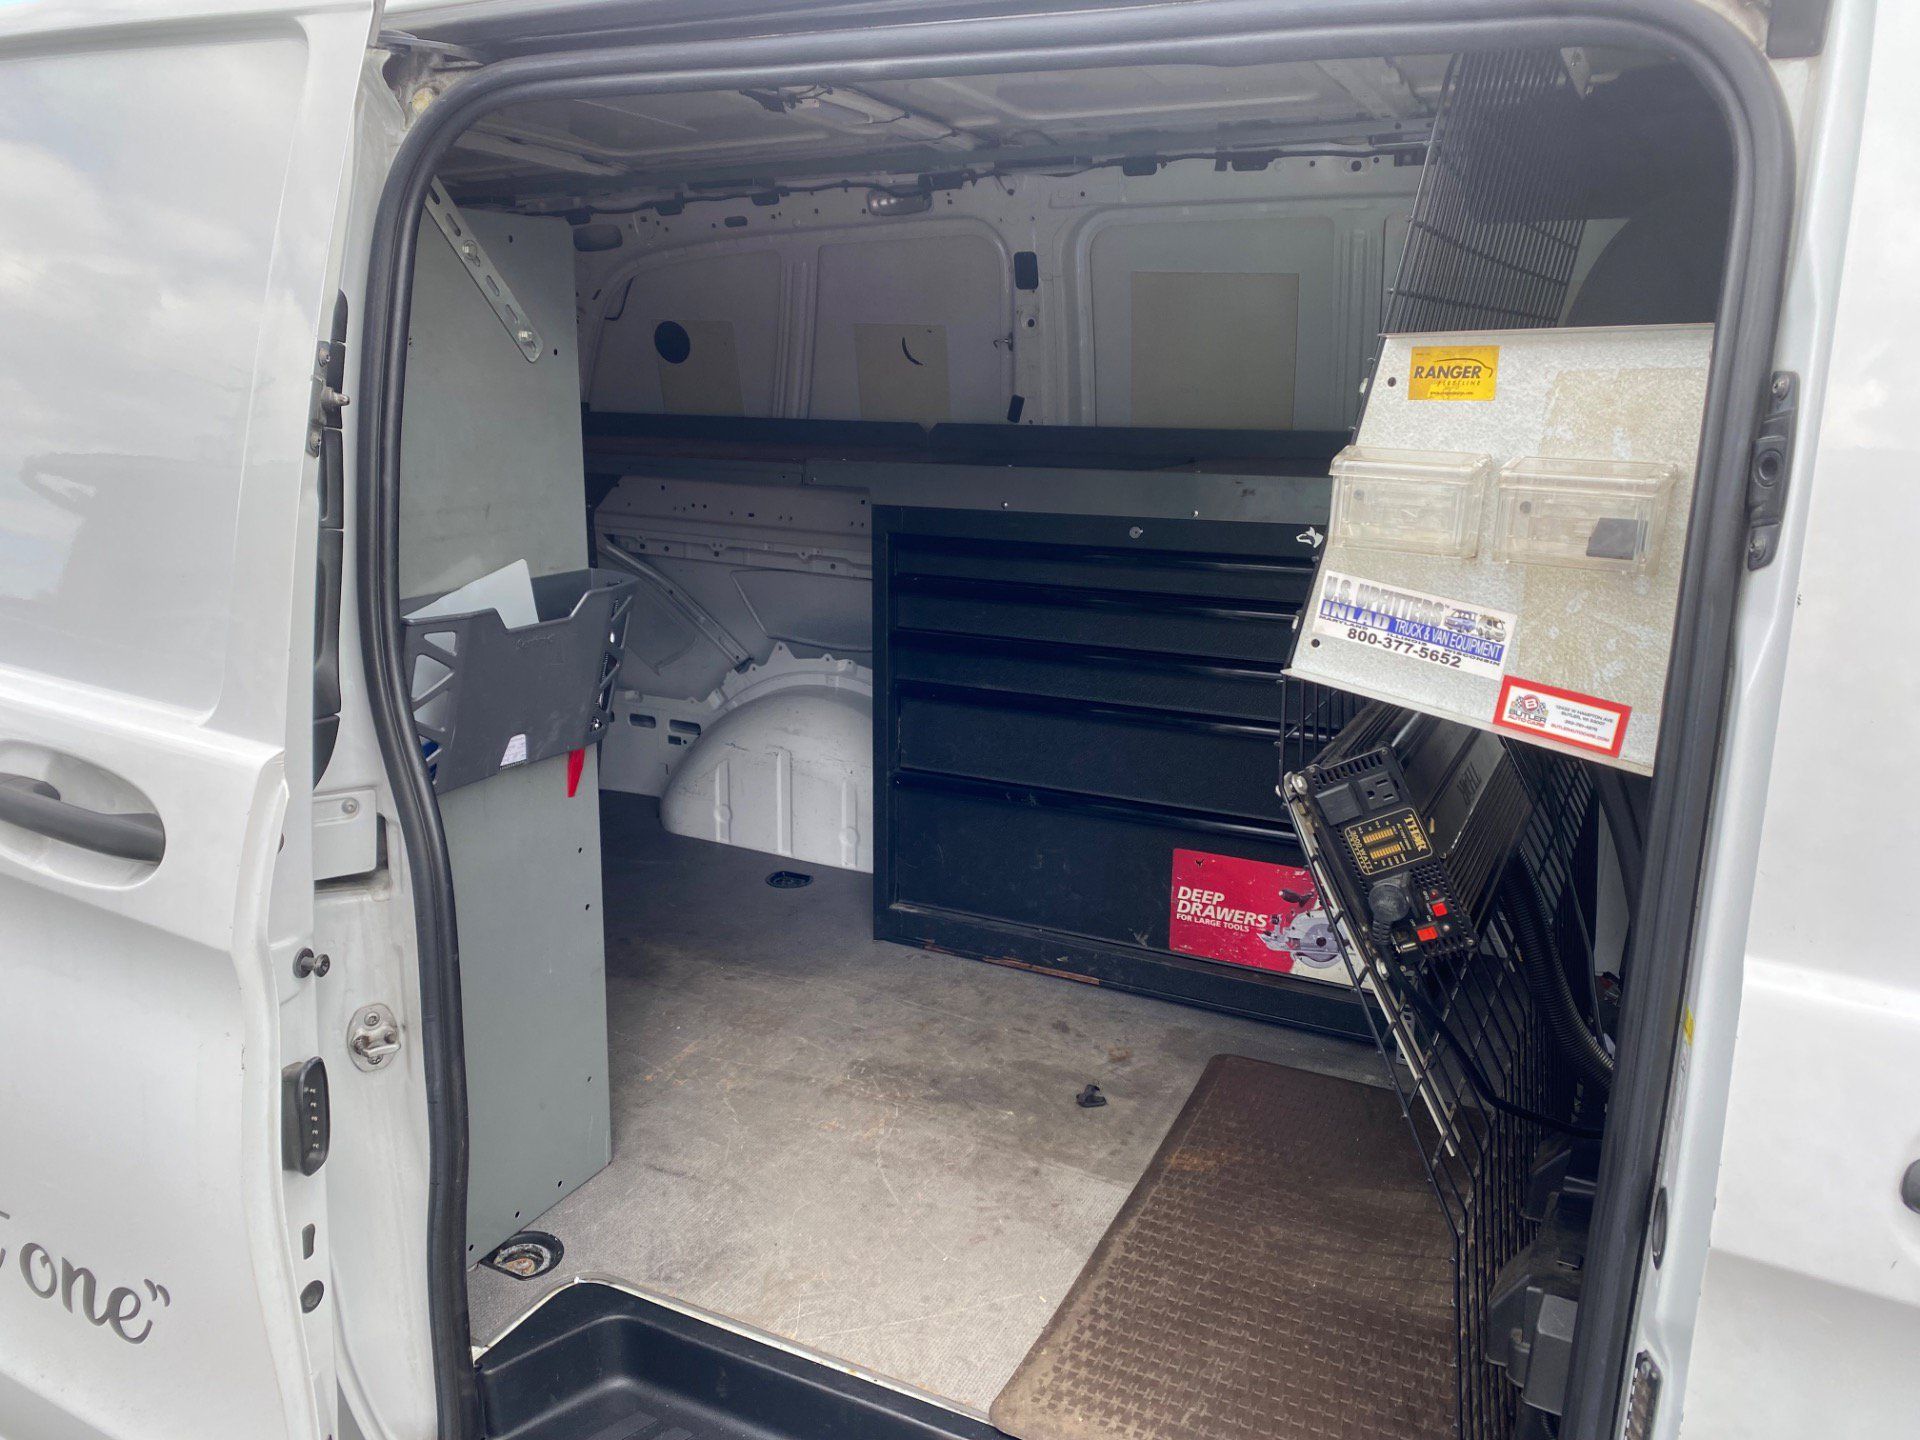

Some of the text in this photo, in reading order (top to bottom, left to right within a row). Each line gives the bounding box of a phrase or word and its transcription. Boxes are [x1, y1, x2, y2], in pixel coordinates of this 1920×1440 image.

[1414, 365, 1482, 379] RANGER
[1325, 575, 1445, 627] U.S. UPFITTERS
[1319, 615, 1368, 630] MARYLAND
[1444, 648, 1501, 666] WISCONSIN
[1321, 600, 1504, 660] INLAD TRUCK & VAN EQUIPMENT
[1347, 628, 1462, 668] 800-377-5652
[1508, 714, 1526, 723] AUTO
[1509, 708, 1547, 723] BUTLER
[1177, 886, 1225, 905] DEEP
[1176, 913, 1250, 932] FOR LARGE TOOLS
[1177, 900, 1268, 927] DRAWERS
